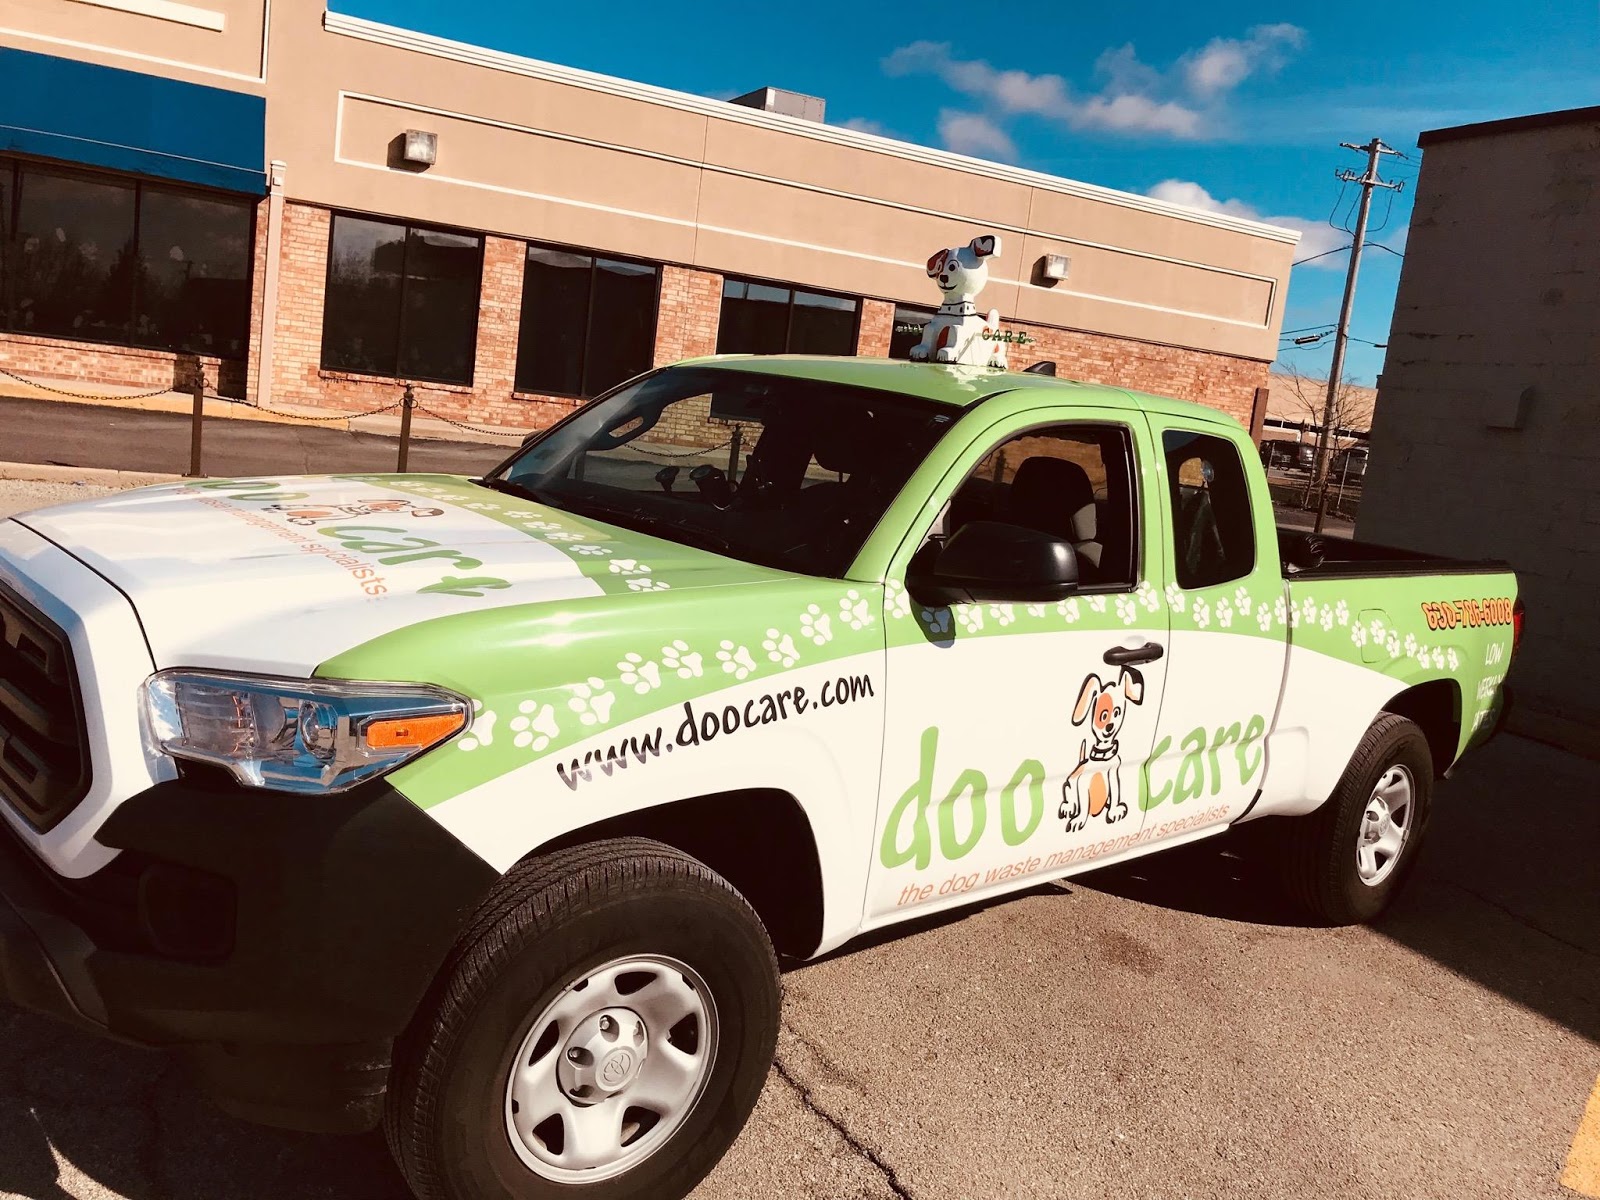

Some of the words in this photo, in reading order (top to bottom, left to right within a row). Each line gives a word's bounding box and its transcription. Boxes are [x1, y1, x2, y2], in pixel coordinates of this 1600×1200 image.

[1420, 597, 1512, 631] 630-786-6008
[1484, 641, 1505, 666] LOW
[556, 674, 875, 791] www.doocare.com
[879, 725, 1046, 871] doo
[1137, 714, 1266, 813] care
[896, 882, 934, 906] the
[938, 872, 980, 893] dog
[984, 855, 1042, 884] waste
[1043, 824, 1158, 869] management
[1156, 803, 1231, 838] specialists
